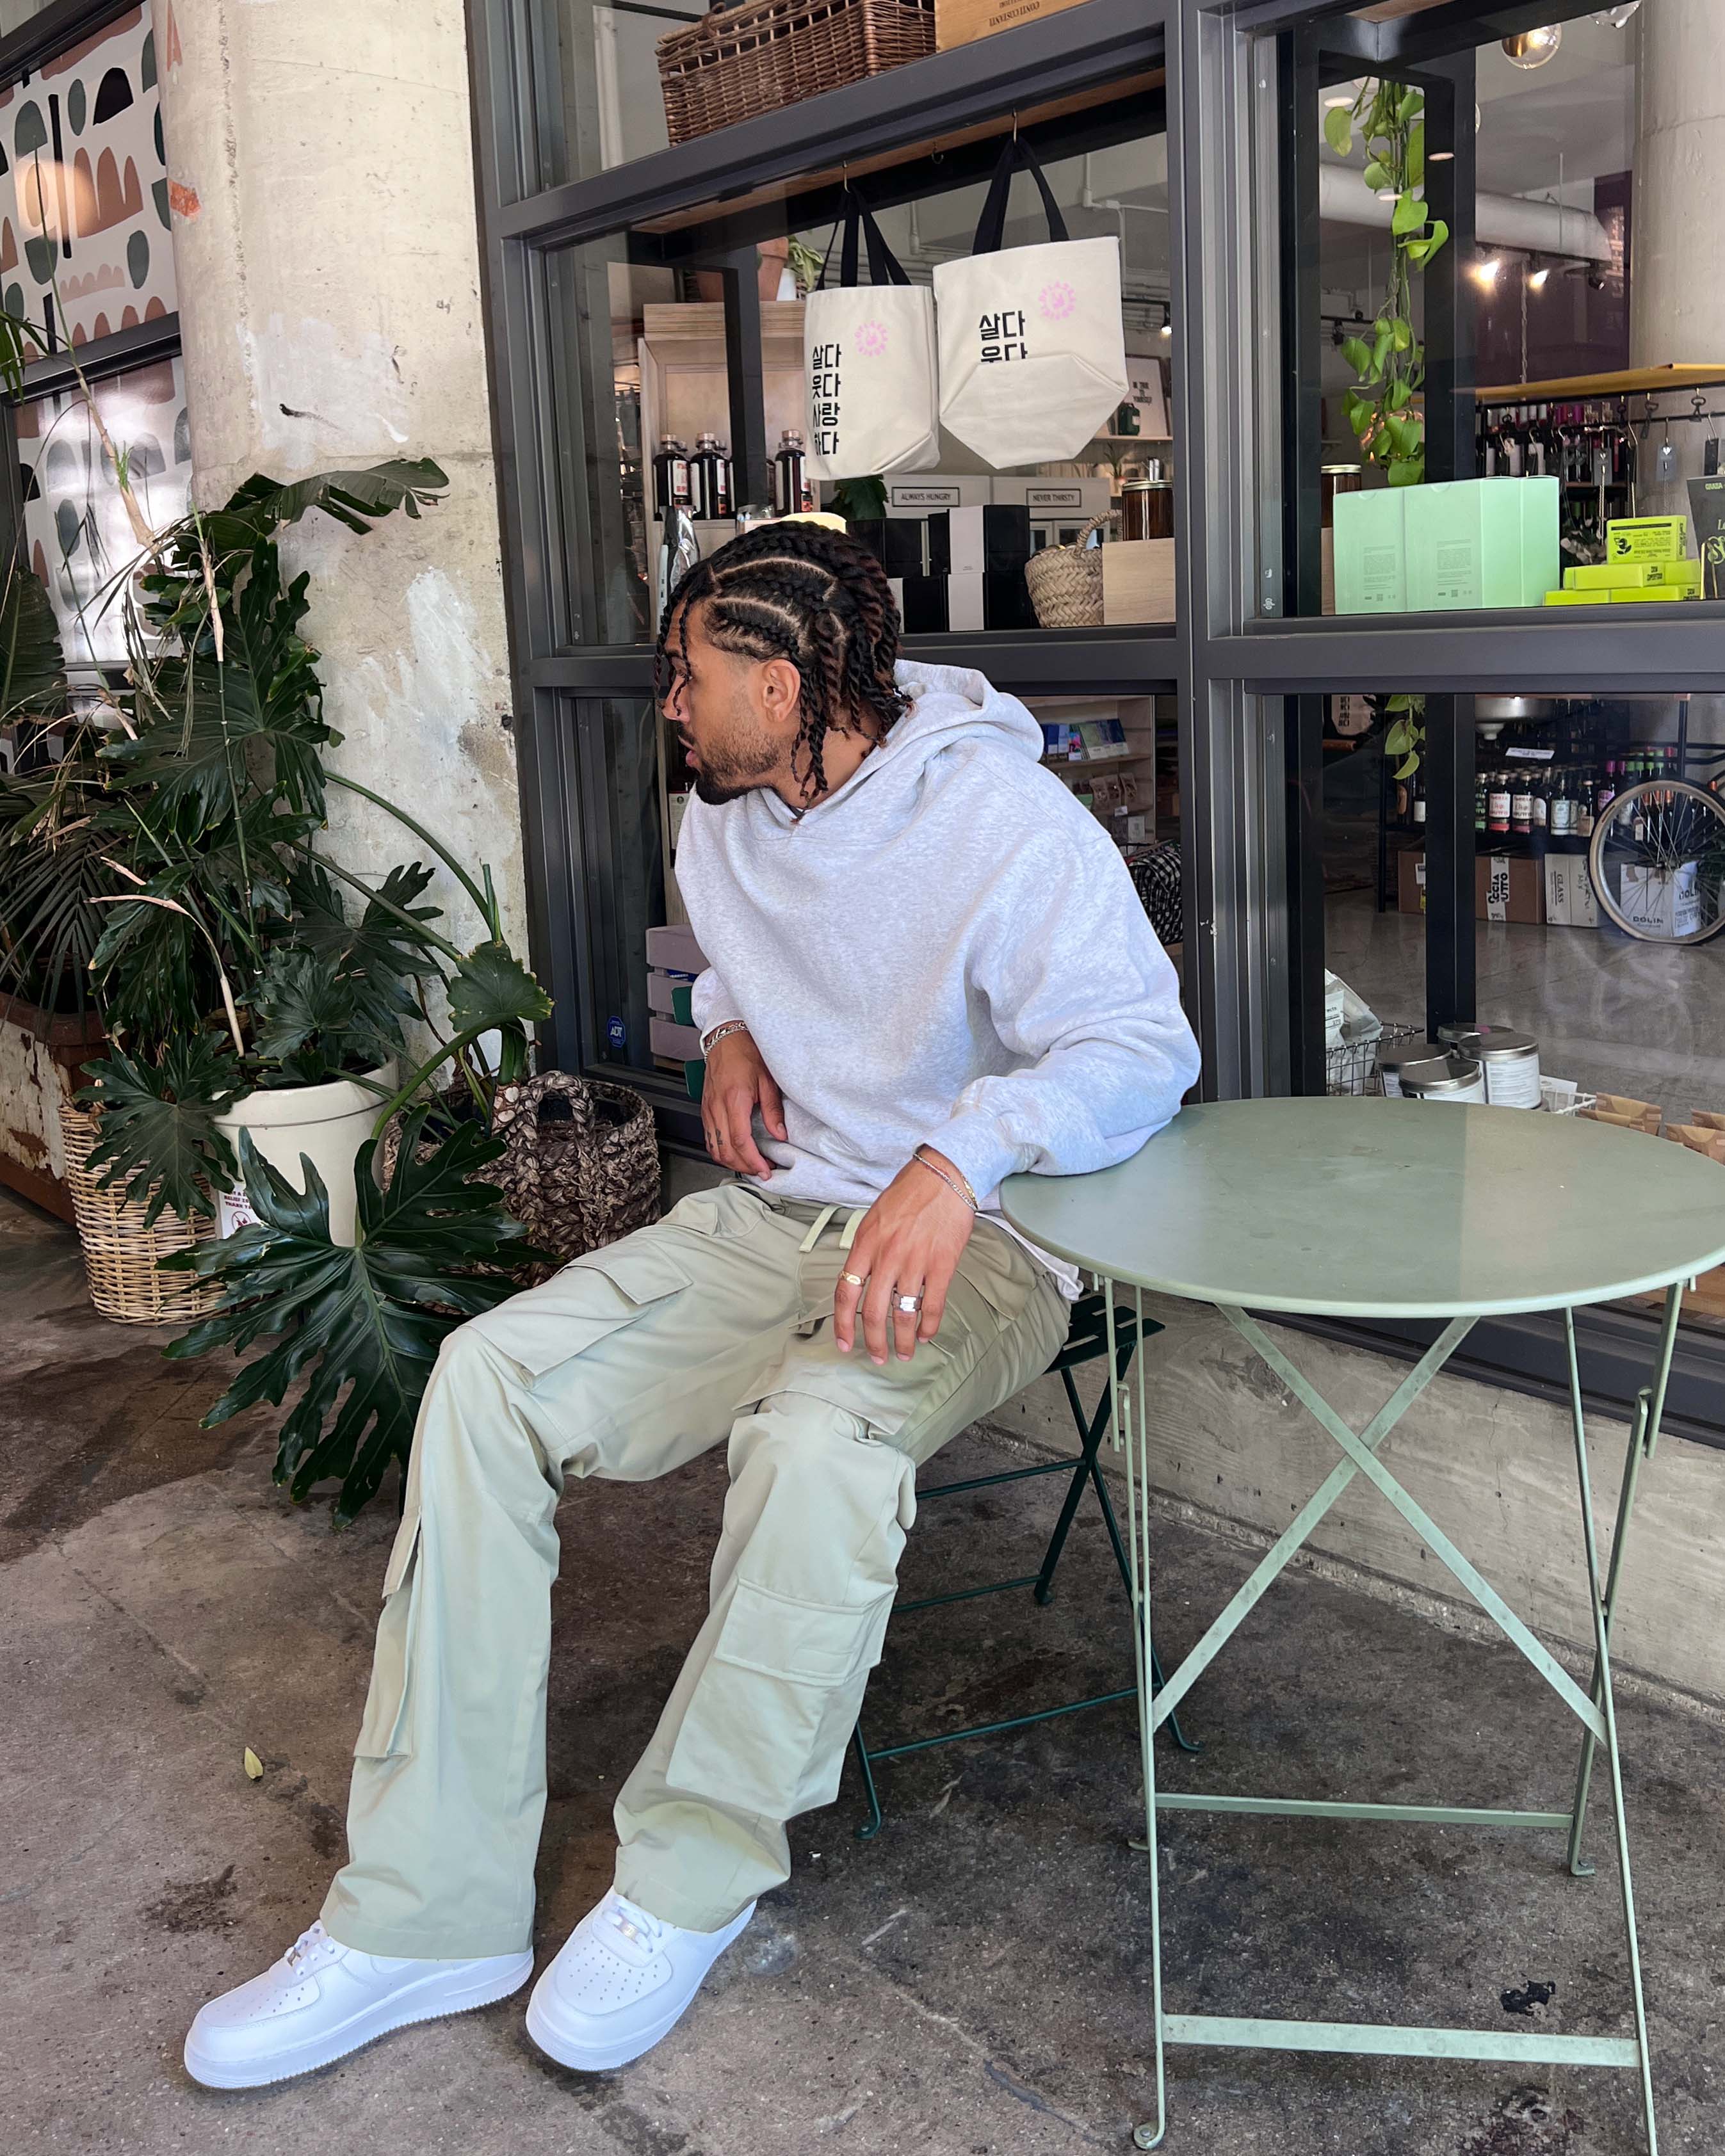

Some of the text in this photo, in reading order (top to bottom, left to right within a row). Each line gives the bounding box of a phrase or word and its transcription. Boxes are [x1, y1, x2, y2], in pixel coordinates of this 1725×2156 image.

[979, 310, 1026, 341] 살다
[813, 343, 842, 370] 살다
[812, 373, 841, 399] 웃다
[813, 402, 841, 427] 사랑
[814, 431, 839, 456] 하다
[901, 492, 925, 501] ALWAYS
[1032, 494, 1051, 502] NEVER
[610, 1026, 622, 1037] ADT
